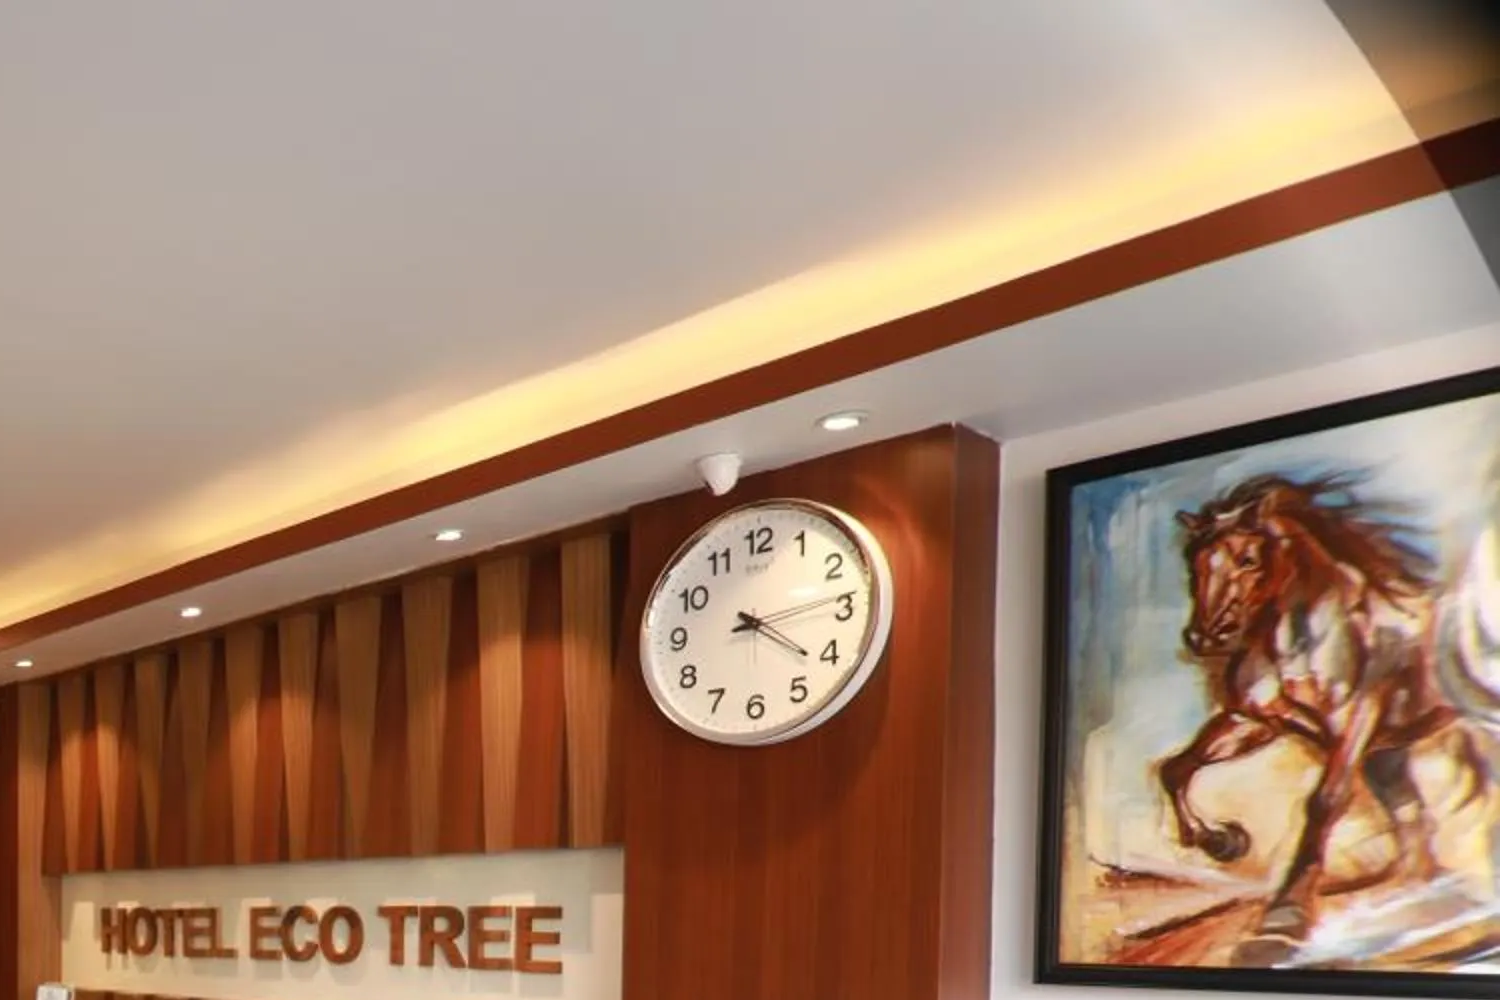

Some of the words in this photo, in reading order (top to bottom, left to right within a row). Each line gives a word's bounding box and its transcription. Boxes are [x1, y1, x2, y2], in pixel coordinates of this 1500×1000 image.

[744, 527, 774, 556] 12
[793, 530, 806, 557] 1
[707, 548, 731, 576] 11
[824, 552, 843, 581] 2
[678, 585, 709, 613] 10
[835, 593, 854, 622] 3
[670, 627, 688, 651] 9
[819, 639, 840, 666] 4
[679, 664, 697, 689] 8
[789, 676, 809, 703] 5
[707, 687, 726, 714] 7
[745, 693, 765, 719] 6
[99, 905, 238, 959] HOTEL
[249, 904, 365, 965] ECO
[377, 904, 564, 975] TREE
